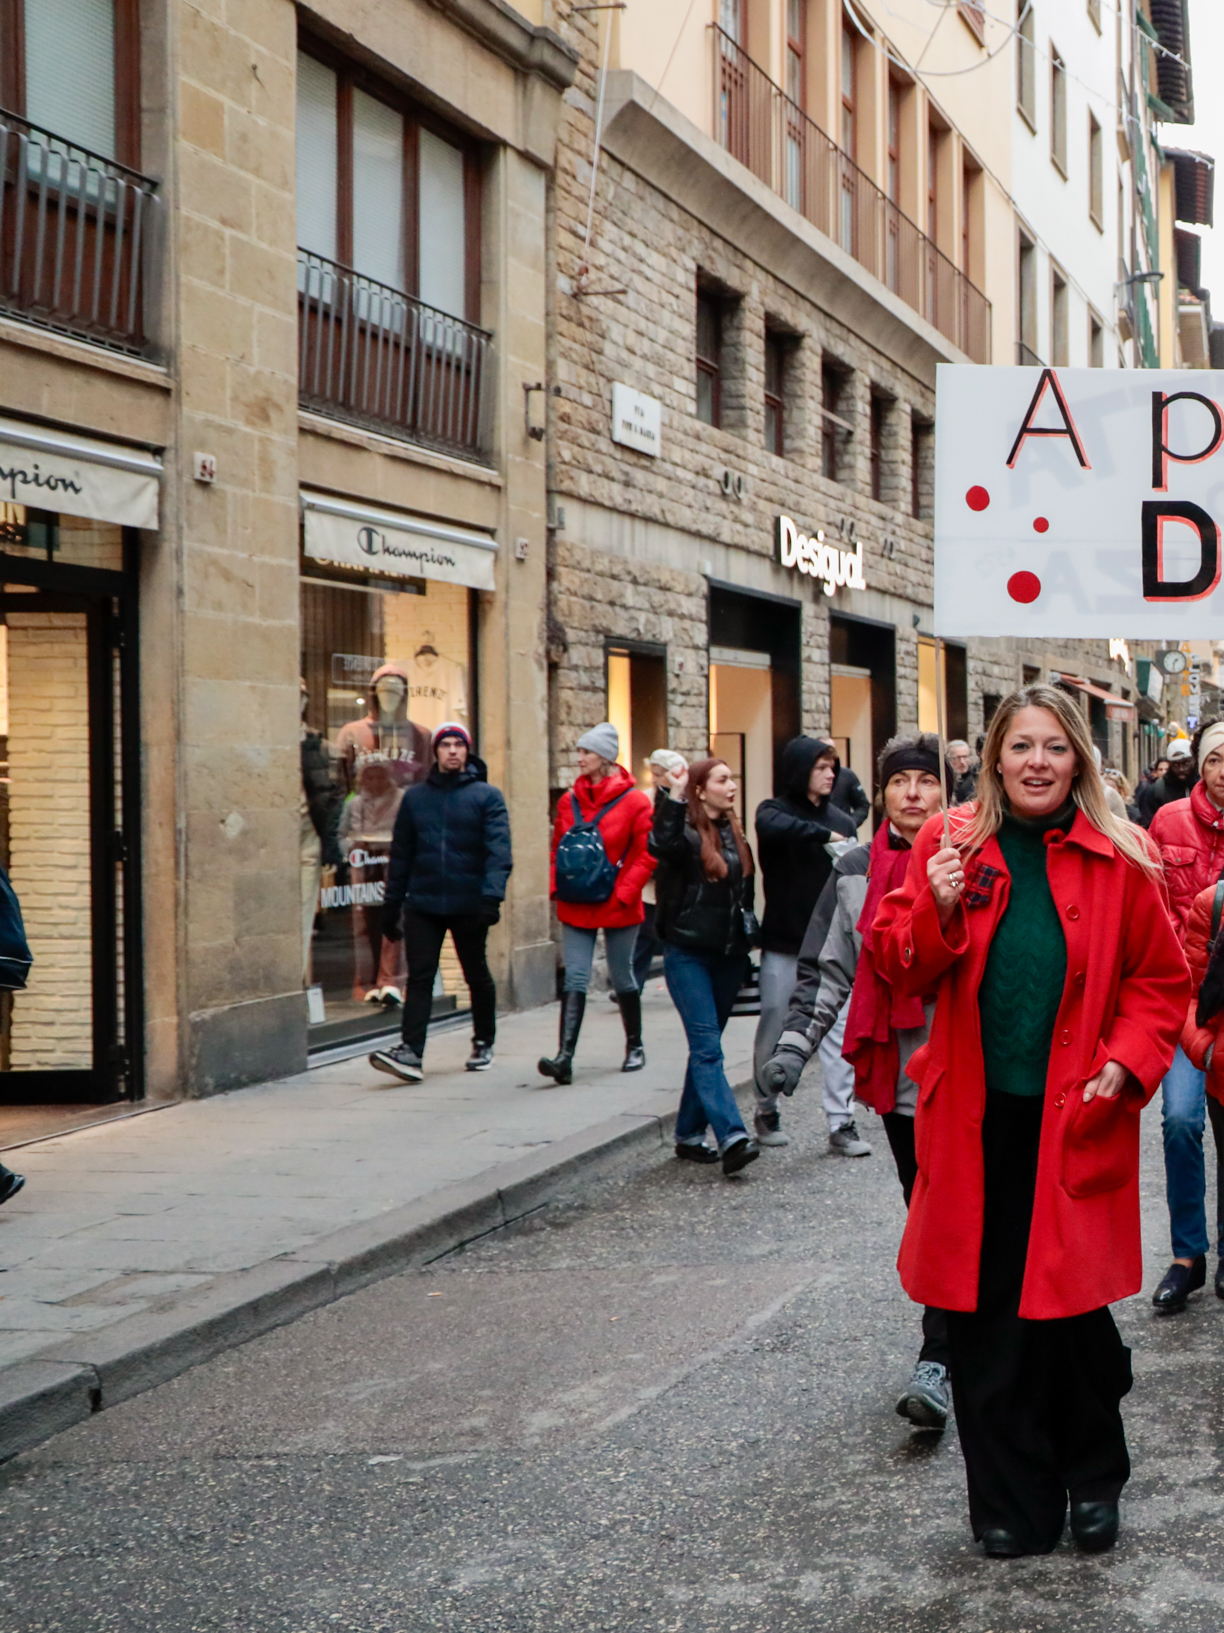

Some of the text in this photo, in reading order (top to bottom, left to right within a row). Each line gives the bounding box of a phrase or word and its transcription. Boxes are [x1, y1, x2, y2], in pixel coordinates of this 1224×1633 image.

[1006, 369, 1091, 469] A
[357, 526, 456, 573] Champion
[349, 848, 390, 868] Cham
[321, 881, 386, 909] MOUNTAINS
